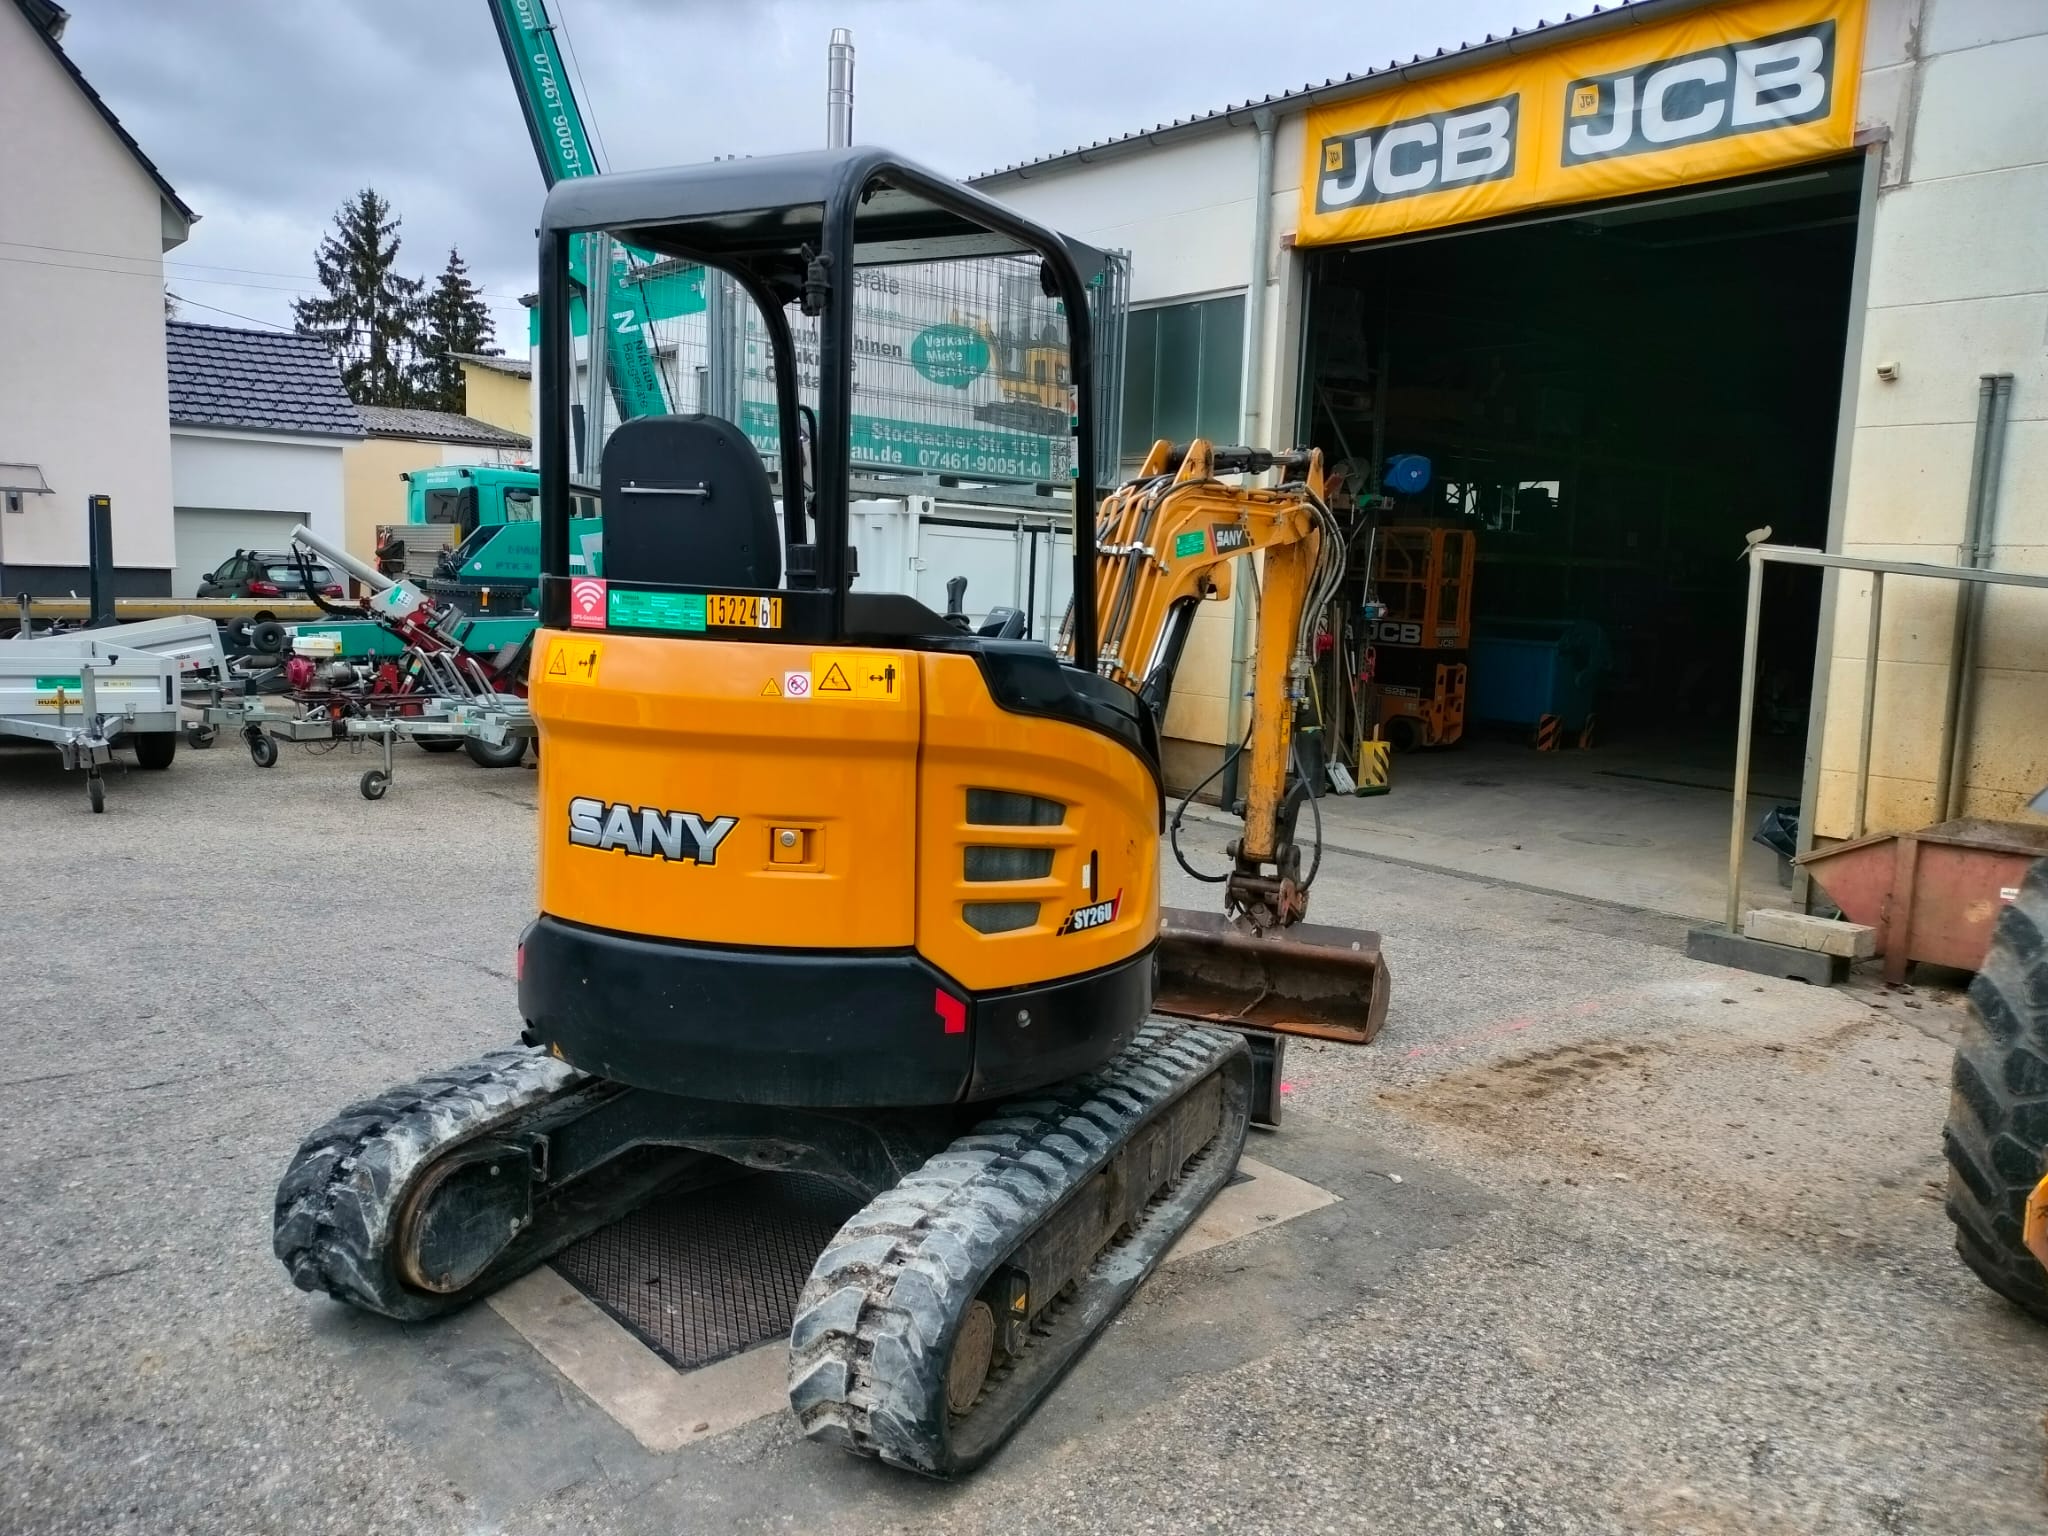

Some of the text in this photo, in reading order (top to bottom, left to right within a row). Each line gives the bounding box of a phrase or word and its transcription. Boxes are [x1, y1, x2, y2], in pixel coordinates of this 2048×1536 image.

[533, 53, 562, 108] 07461
[1569, 36, 1824, 157] JCB
[1321, 105, 1511, 206] JCB
[612, 309, 640, 334] N
[924, 334, 975, 348] Verkauf
[633, 339, 655, 391] Niklaus
[926, 350, 963, 363] Miete
[929, 363, 978, 379] Service
[871, 422, 1006, 454] Stockacher-Str.
[1012, 440, 1040, 457] 103
[918, 449, 1041, 477] 07461-90051-0
[1216, 530, 1242, 547] SANY
[1367, 622, 1421, 644] JCB
[569, 797, 739, 865] SANY
[1074, 902, 1112, 929] SY26U
